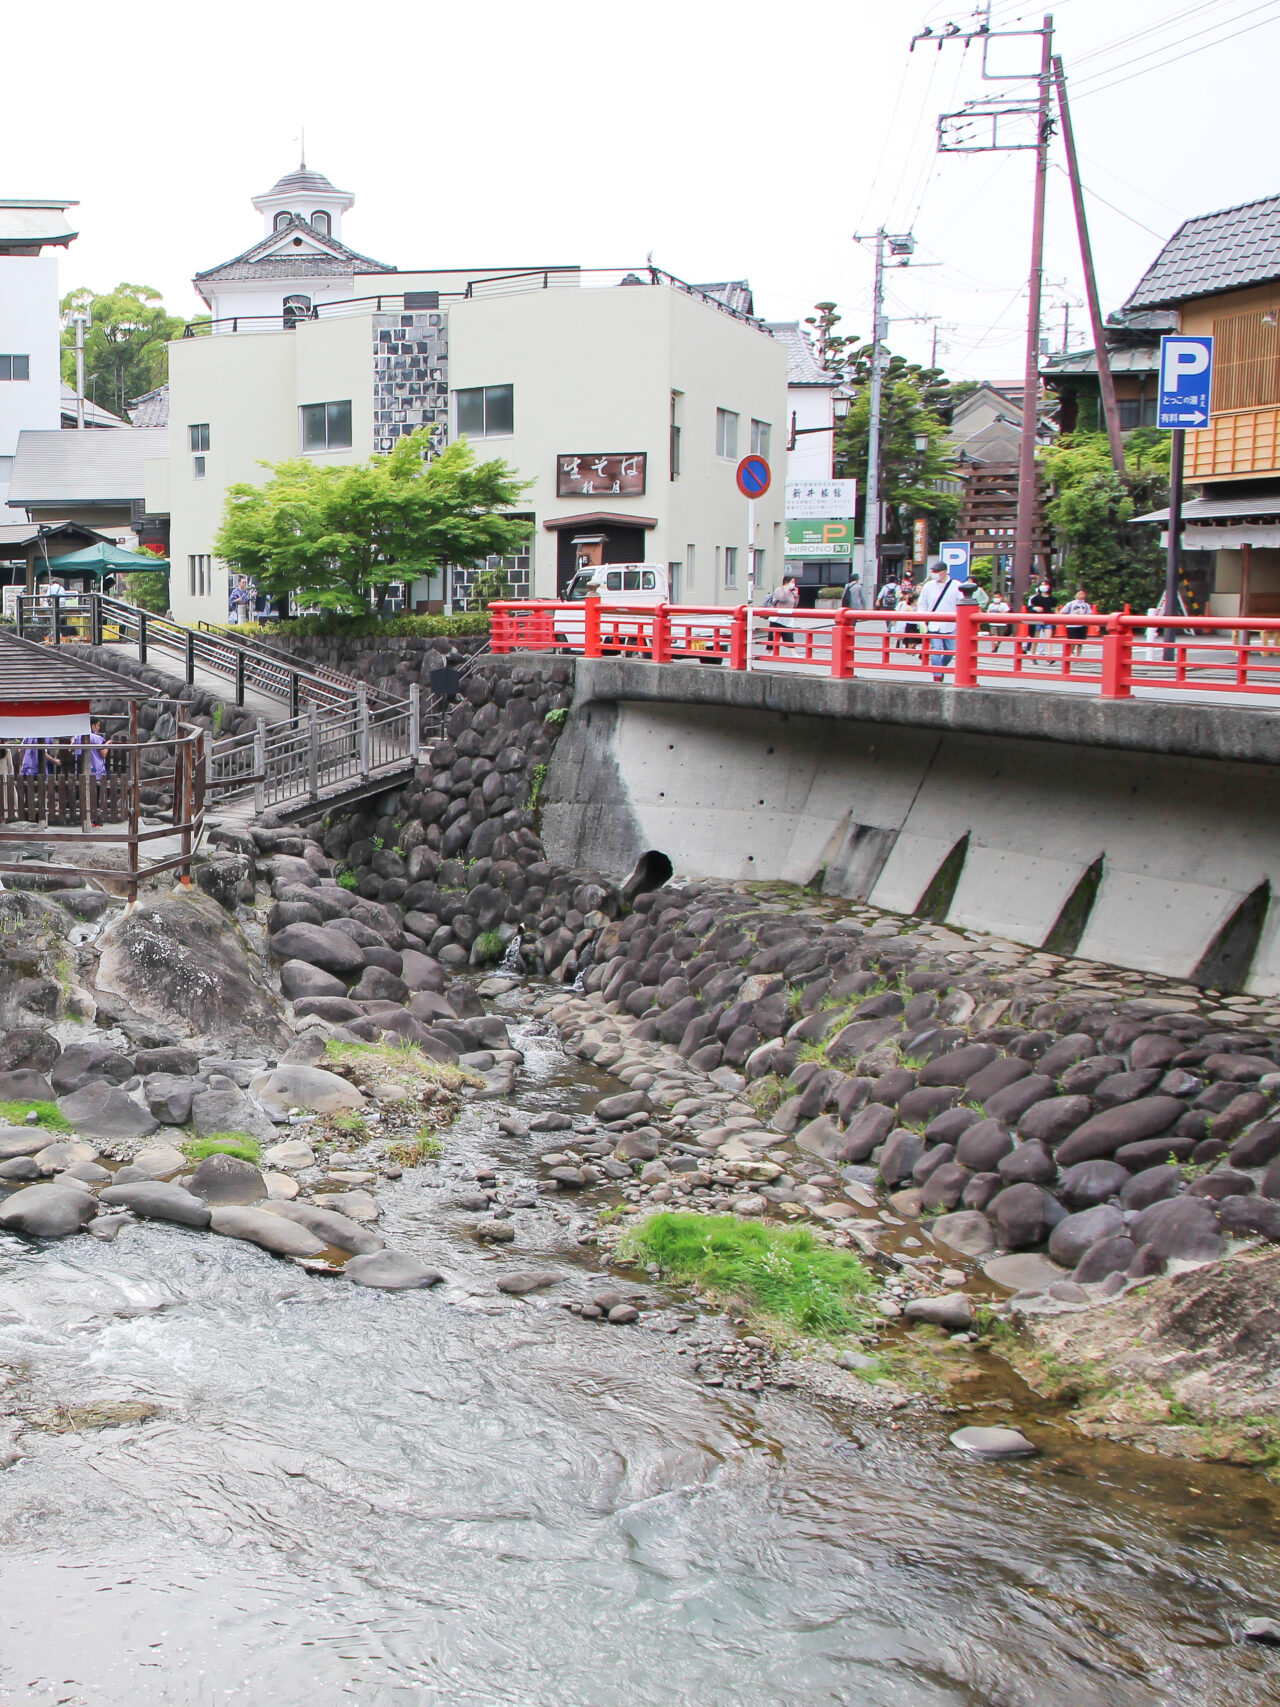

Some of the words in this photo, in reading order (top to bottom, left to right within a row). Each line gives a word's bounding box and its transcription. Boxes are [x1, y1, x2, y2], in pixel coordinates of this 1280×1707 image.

[1164, 342, 1209, 392] P
[1161, 413, 1178, 423] 有料
[563, 457, 642, 480] 生そば
[823, 523, 847, 543] P
[789, 545, 832, 553] HIRONO
[943, 548, 968, 574] P
